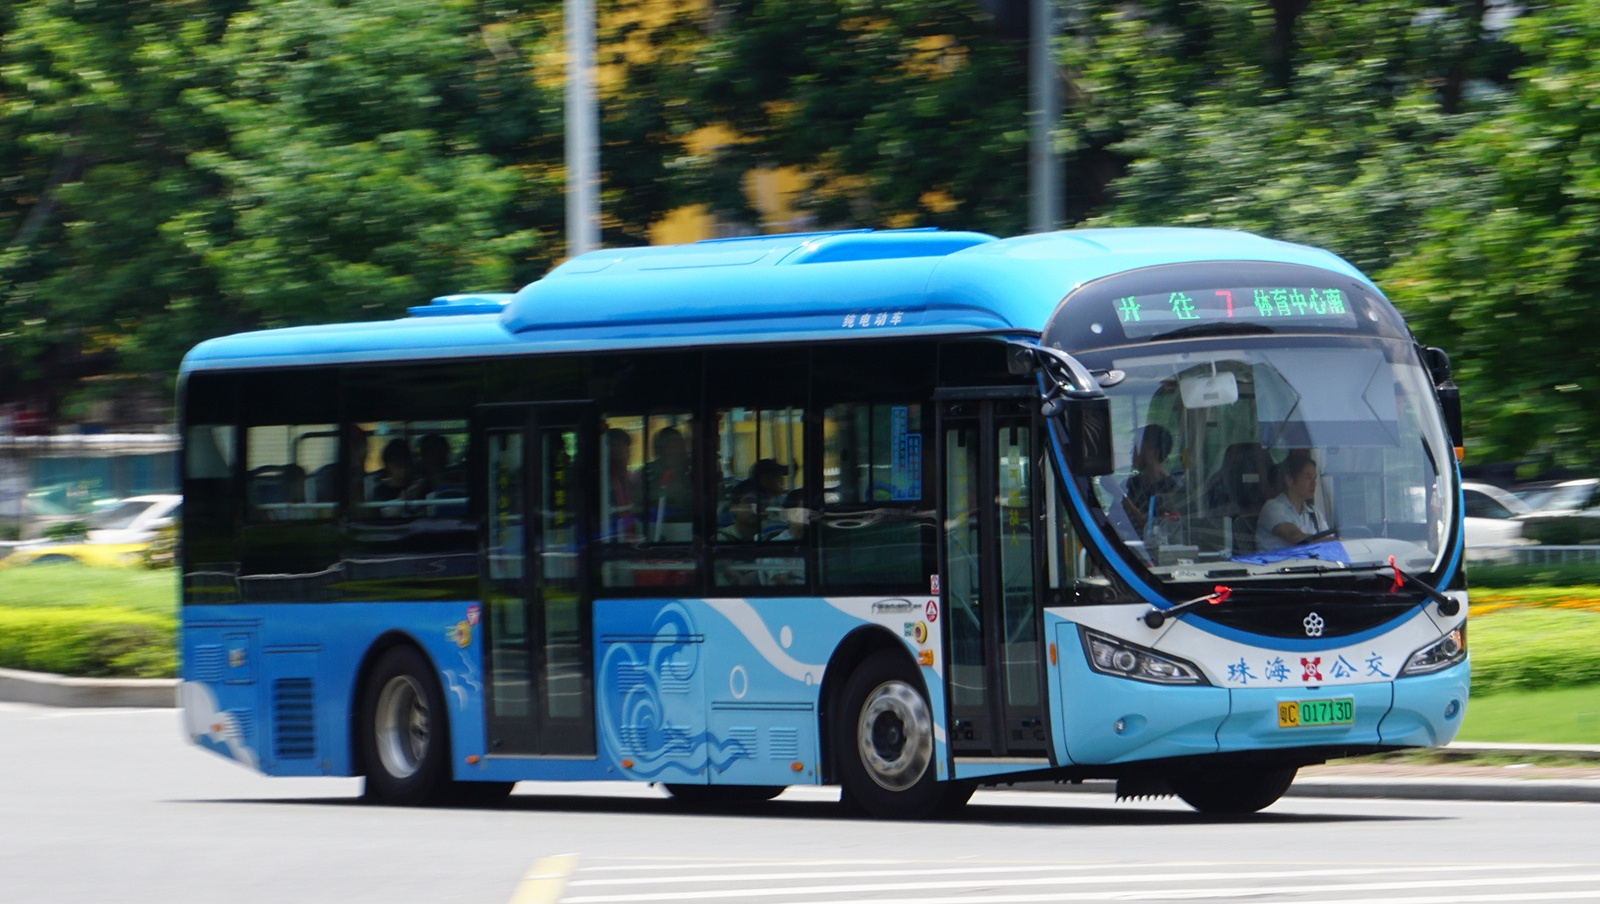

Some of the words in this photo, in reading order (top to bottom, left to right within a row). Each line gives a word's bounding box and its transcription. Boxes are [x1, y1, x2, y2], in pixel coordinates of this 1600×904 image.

[1215, 290, 1233, 318] 7
[841, 311, 904, 328] 纯电动车
